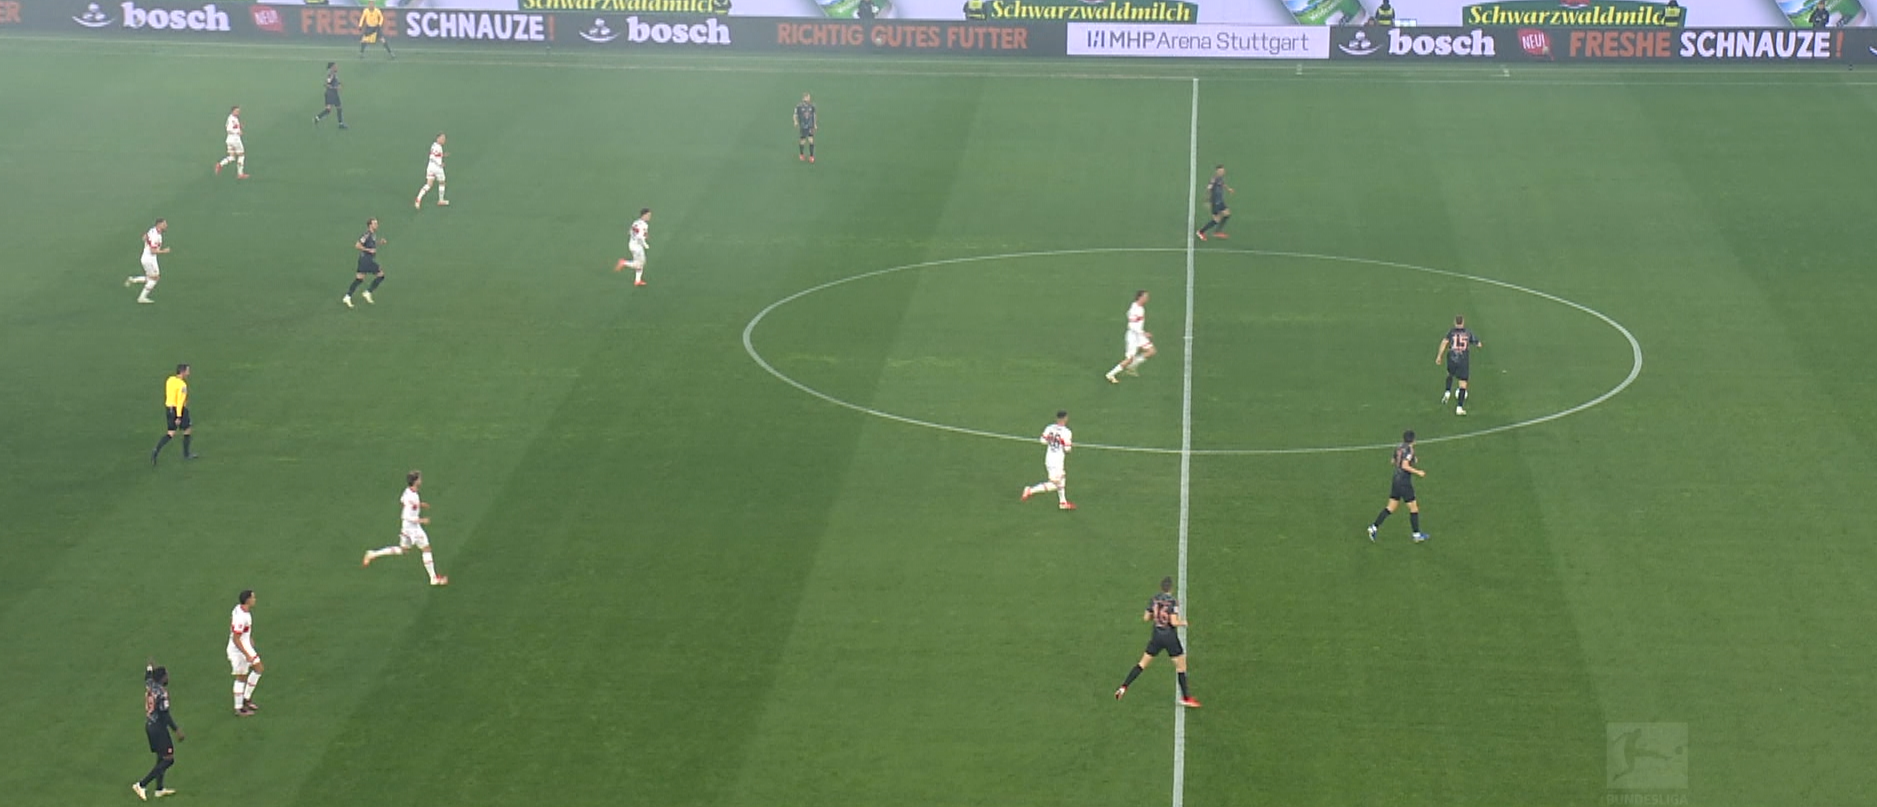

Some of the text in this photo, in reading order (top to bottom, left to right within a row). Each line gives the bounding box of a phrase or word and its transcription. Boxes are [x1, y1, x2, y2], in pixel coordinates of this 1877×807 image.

[121, 2, 230, 31] bosch
[301, 8, 398, 36] FRESE
[991, 1, 1191, 21] Schwarzwaldmilch
[626, 16, 731, 44] bosch
[777, 23, 1028, 49] RICHTIG GUTES FUTTER
[1216, 32, 1309, 54] Stuttgart
[1388, 29, 1496, 56] bosch
[1569, 31, 1672, 57] FRESHE
[1452, 334, 1469, 351] 15
